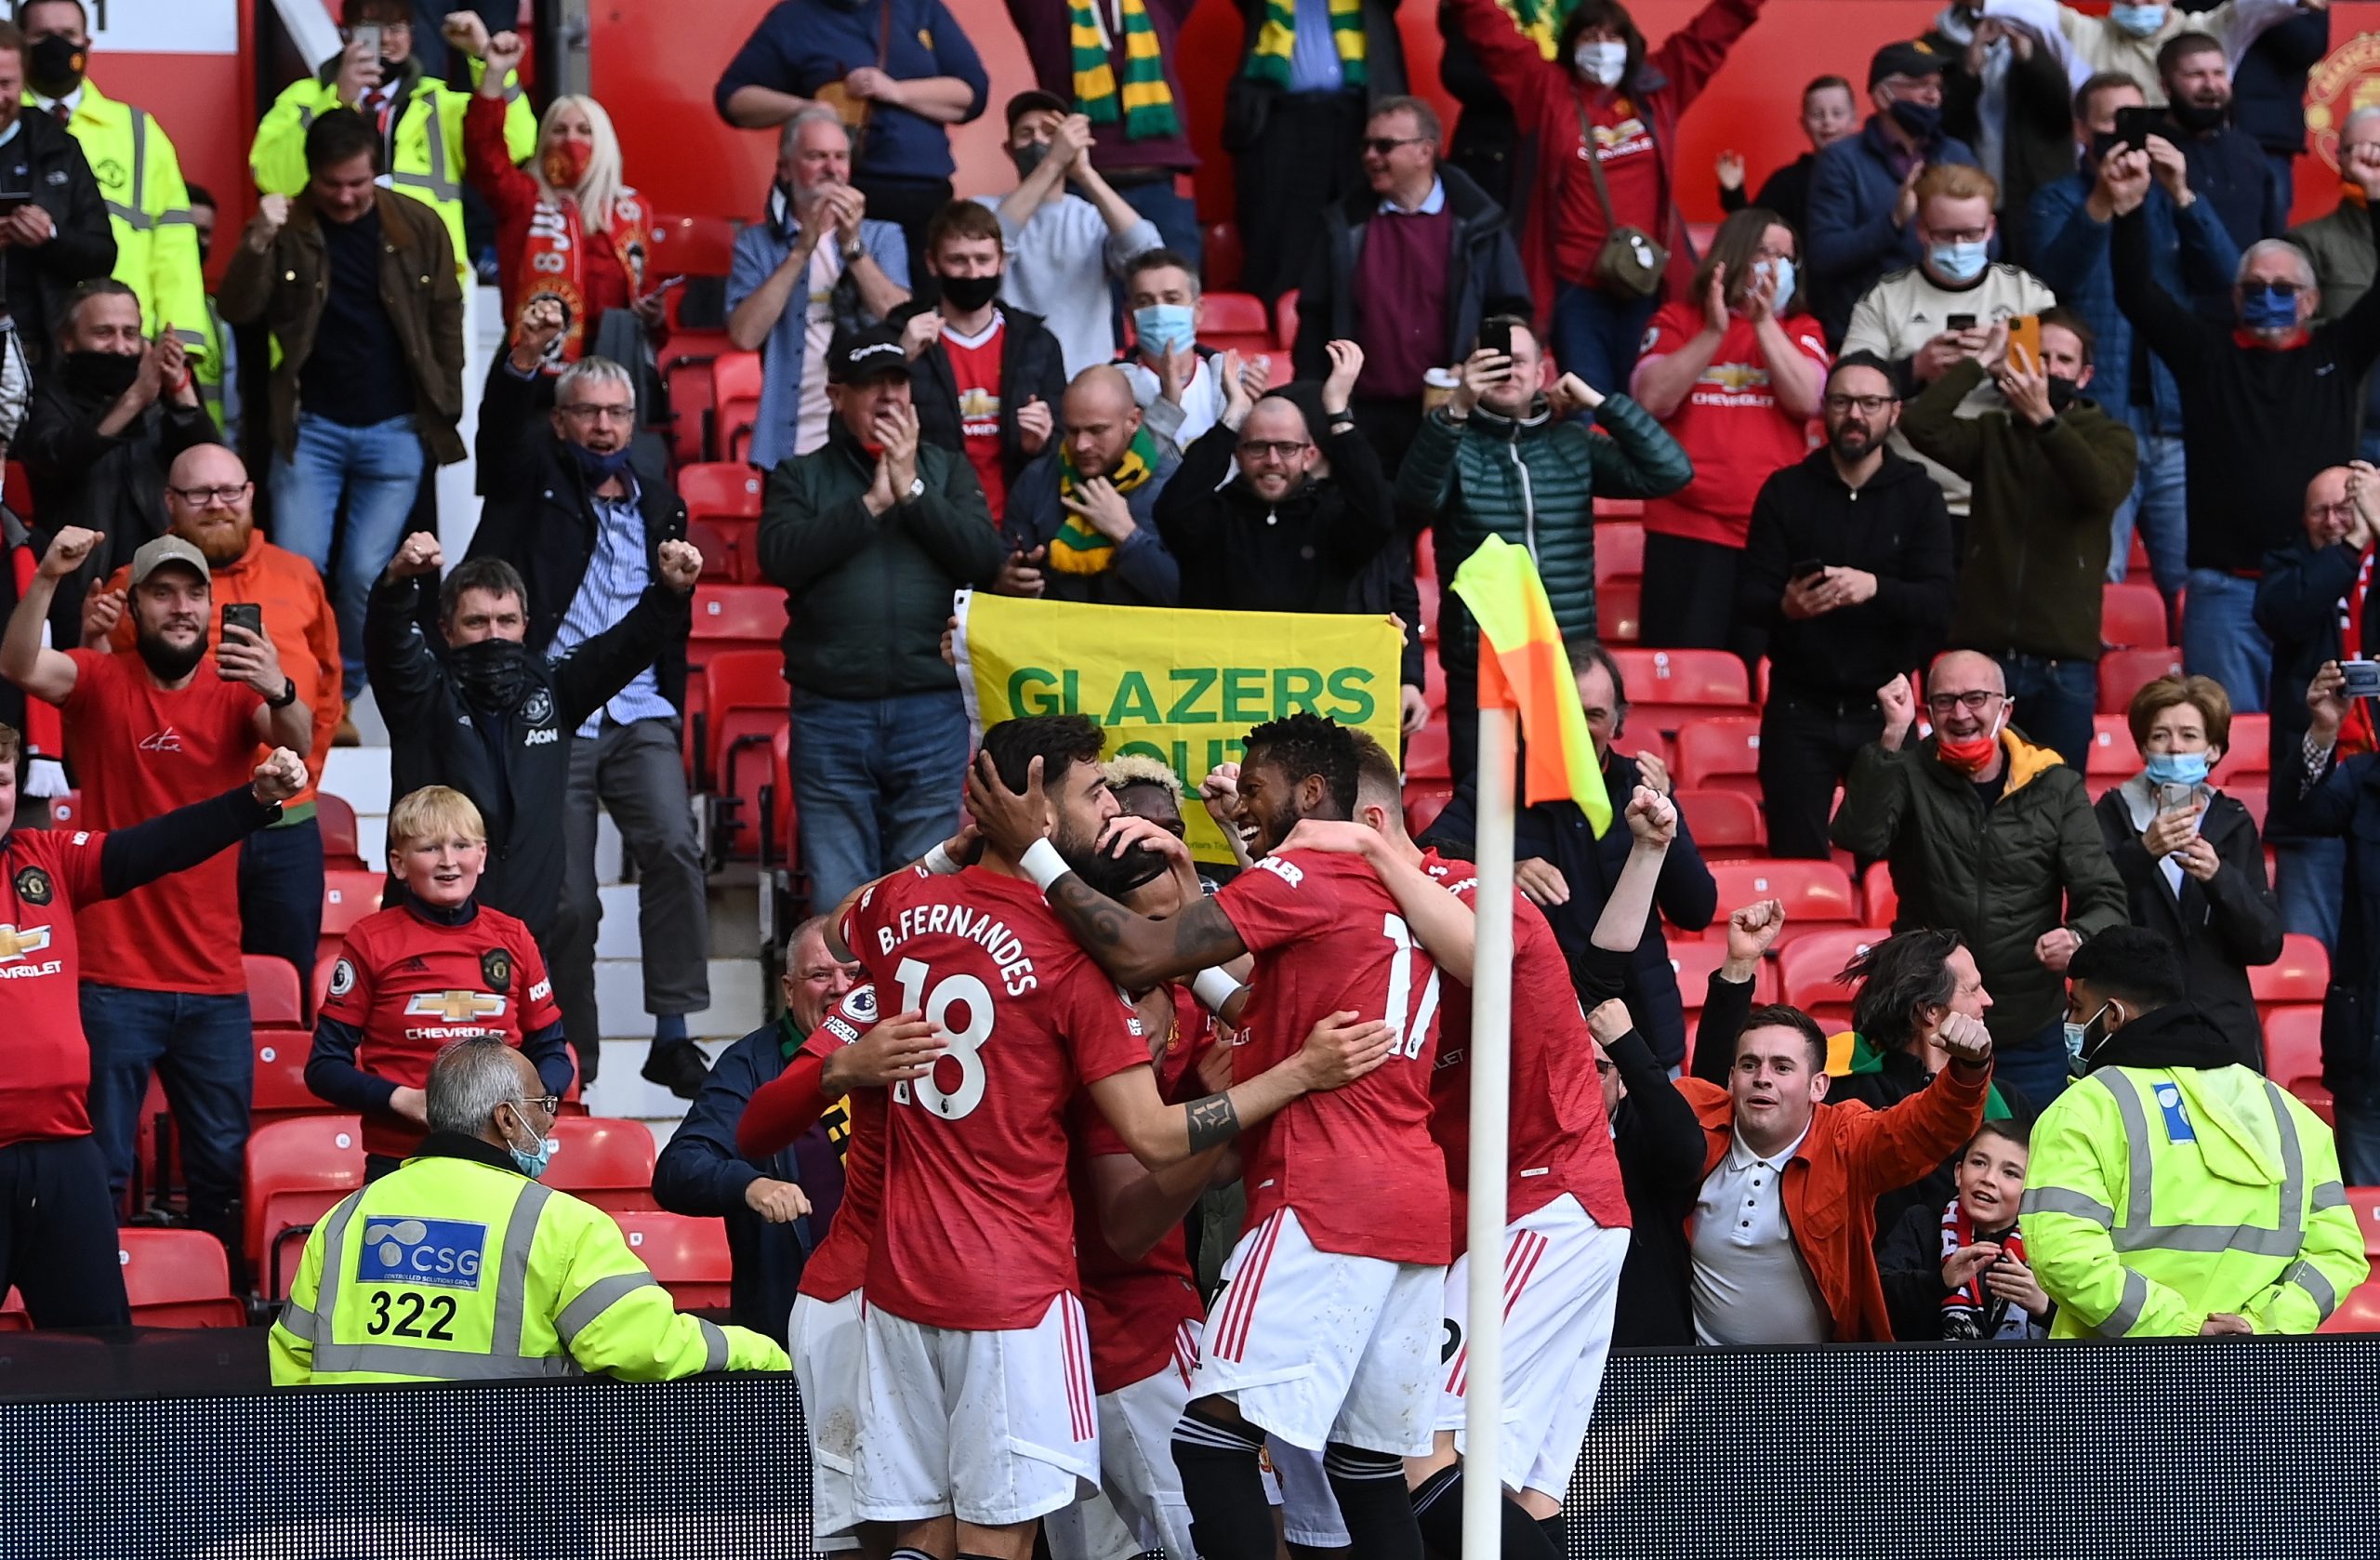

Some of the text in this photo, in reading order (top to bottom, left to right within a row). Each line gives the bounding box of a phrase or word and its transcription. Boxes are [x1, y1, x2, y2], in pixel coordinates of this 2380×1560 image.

[1008, 667, 1376, 726] GLAZERS
[524, 728, 559, 747] AON
[1254, 855, 1304, 890] HLER
[877, 904, 1038, 998] B.FERNANDES
[0, 960, 62, 979] VROLET
[893, 957, 995, 1120] 18
[384, 1273, 421, 1282] CONTROLLED
[411, 1246, 480, 1276] CSG
[366, 1290, 457, 1342] 322
